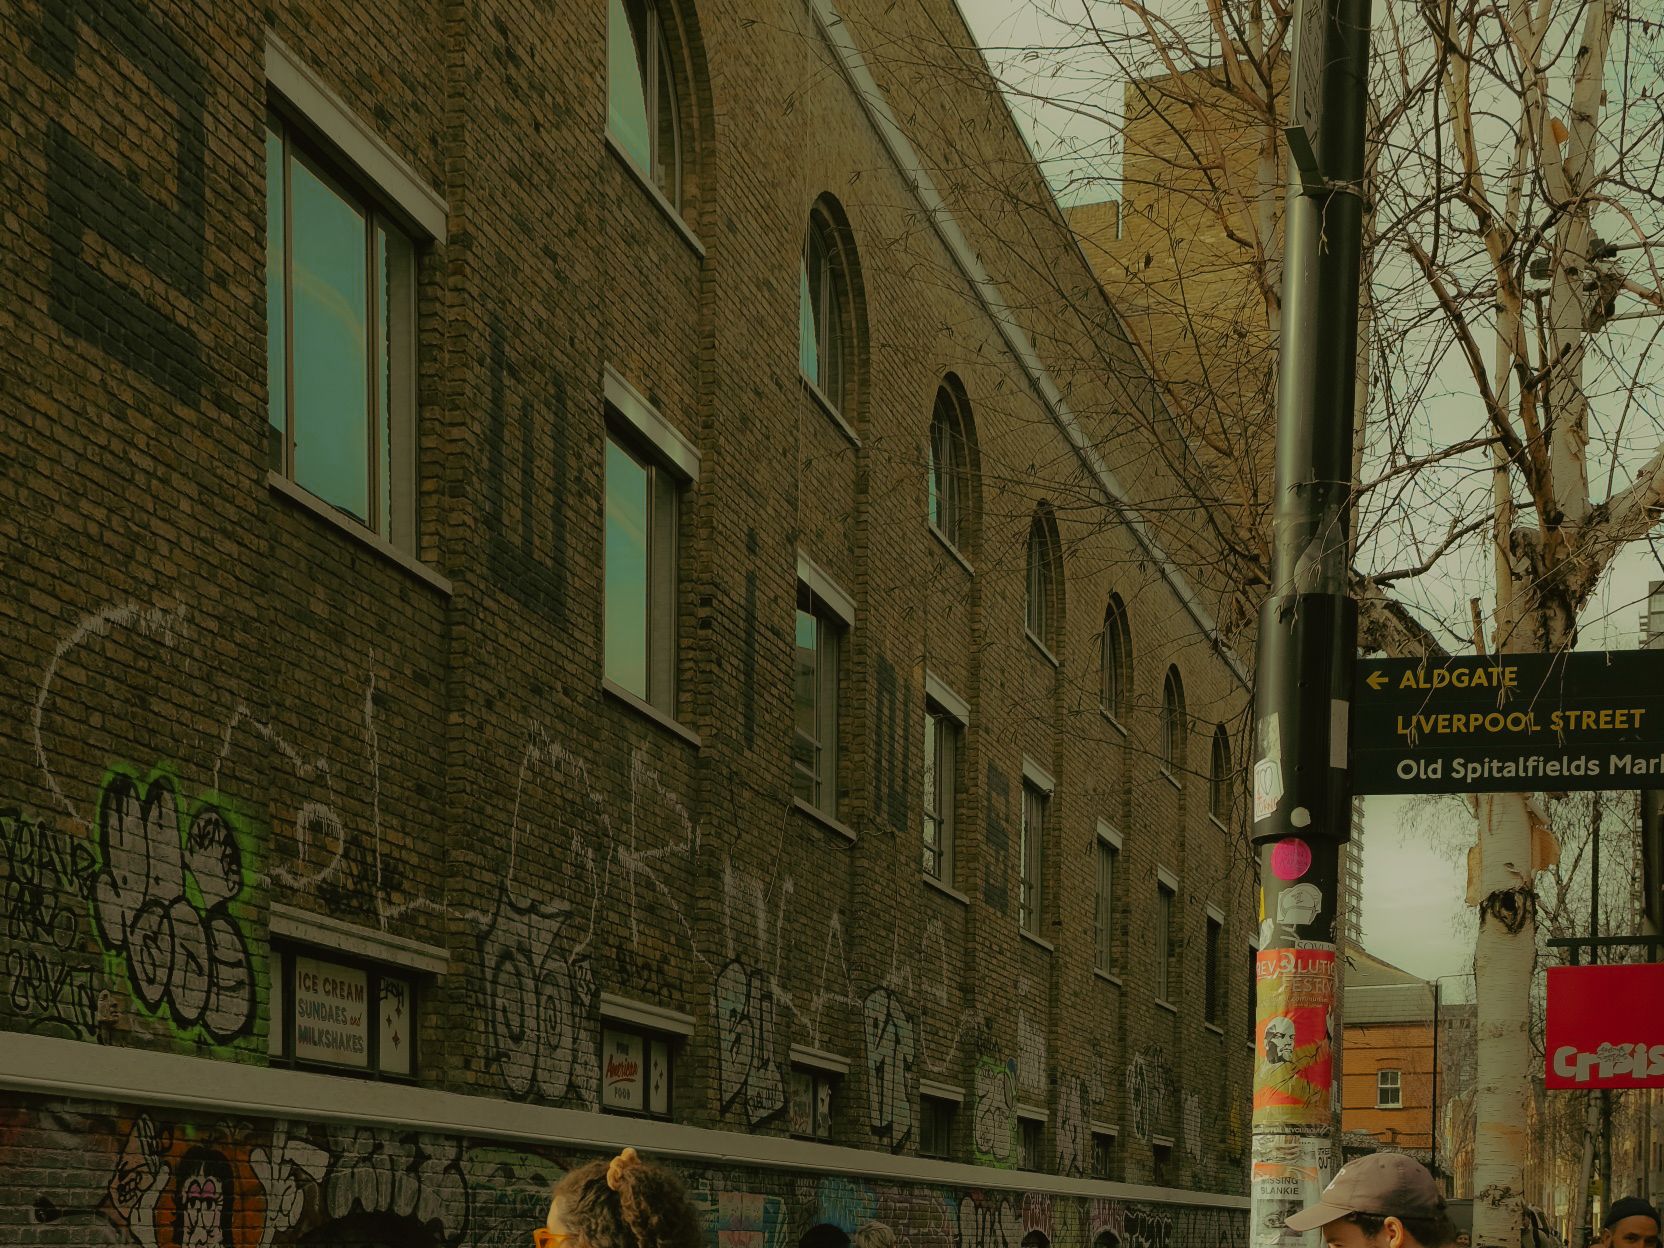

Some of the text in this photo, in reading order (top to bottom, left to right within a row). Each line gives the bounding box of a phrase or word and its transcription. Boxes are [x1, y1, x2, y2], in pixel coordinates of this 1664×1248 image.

[1399, 666, 1518, 689] ALDGATE
[1397, 708, 1646, 735] LIVERPOOL STREET
[1397, 758, 1443, 780] Old
[1452, 755, 1600, 783] Spitalfields
[298, 971, 364, 1004] ICE CREAM
[298, 998, 347, 1026] SUNDAES
[298, 1024, 364, 1054] MILKSHAKES
